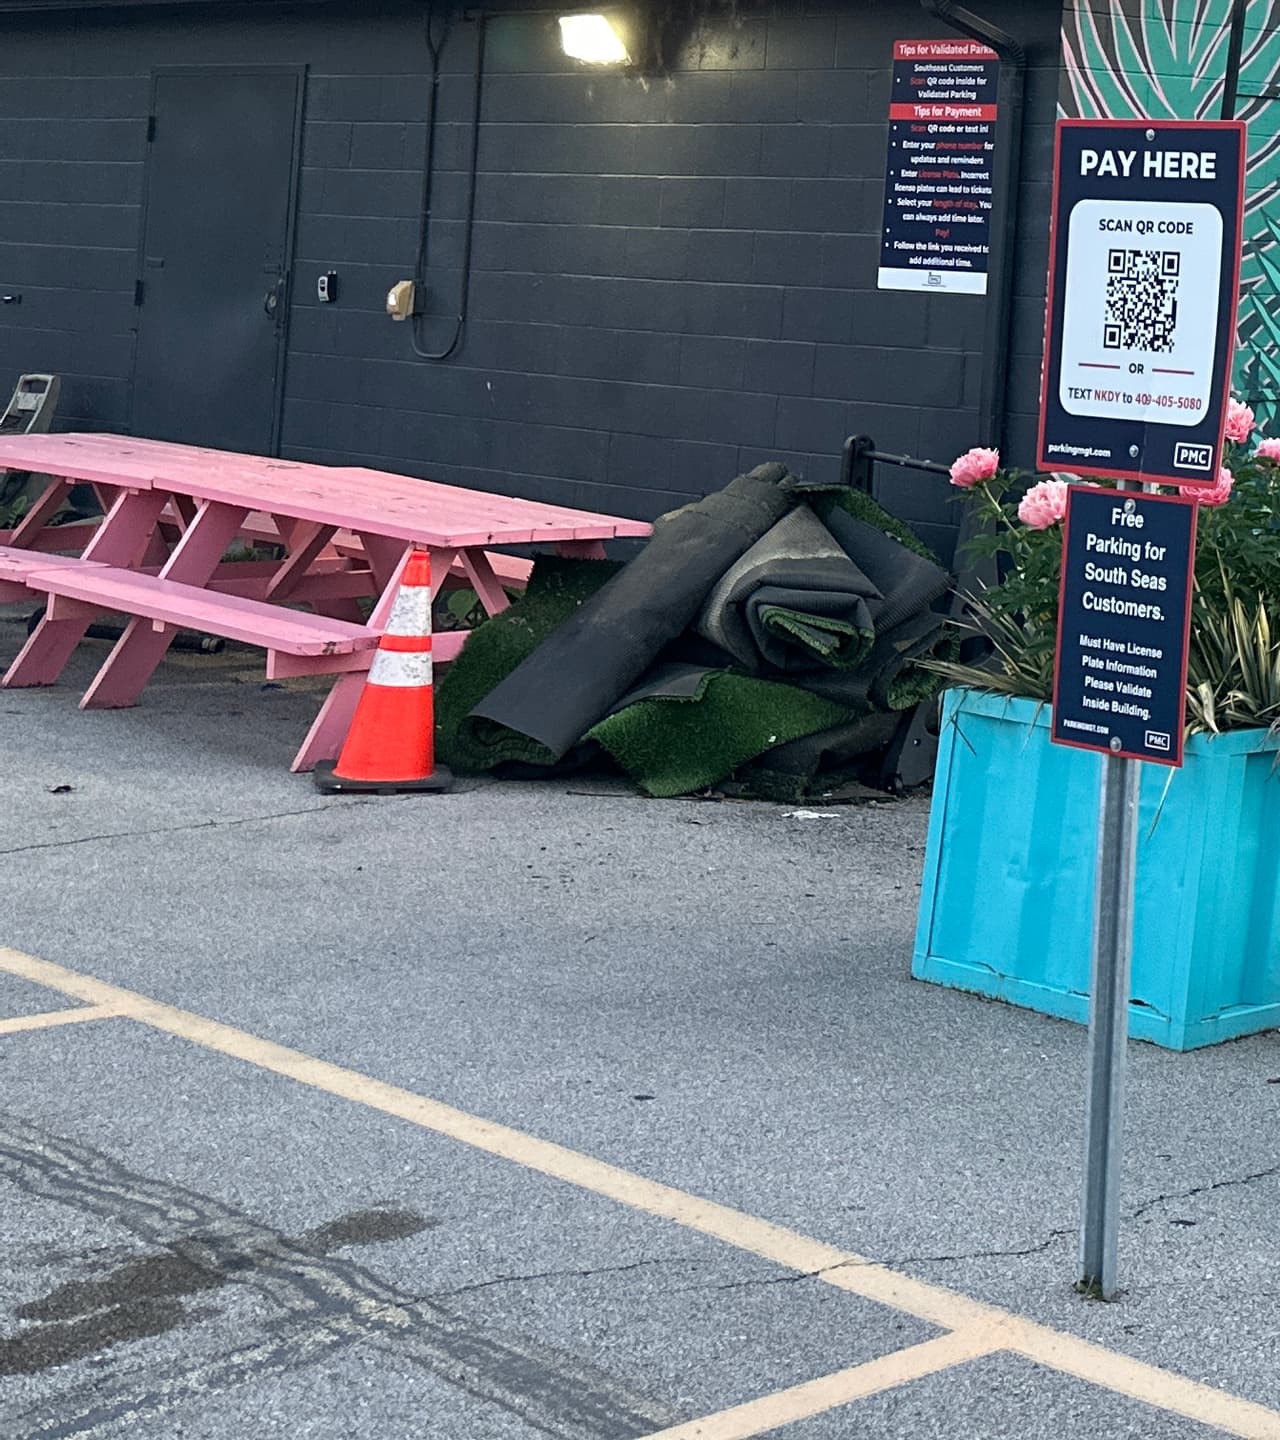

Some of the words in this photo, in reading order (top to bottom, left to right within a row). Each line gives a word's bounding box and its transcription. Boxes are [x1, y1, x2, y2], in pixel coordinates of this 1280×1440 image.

[900, 45, 916, 56] Tips
[917, 44, 928, 54] for
[930, 44, 968, 54] Validated
[948, 64, 984, 72] Customers
[911, 77, 926, 85] Scan
[927, 77, 937, 86] QR
[938, 77, 954, 85] code
[956, 77, 975, 85] inside
[977, 77, 987, 85] for
[918, 90, 949, 98] Validated
[950, 90, 976, 100] Parking
[914, 106, 930, 118] Tips
[932, 106, 944, 116] for
[945, 106, 982, 118] Payment
[927, 125, 938, 134] QR
[939, 125, 956, 133] code
[965, 125, 978, 133] text
[902, 140, 919, 149] Enter
[921, 142, 936, 150] your
[984, 142, 994, 150] for
[911, 155, 936, 164] updates
[937, 156, 950, 164] and
[951, 155, 984, 164] reminders
[1080, 150, 1136, 176] PAY
[1143, 150, 1216, 179] HERE
[901, 169, 918, 177] Enter
[961, 171, 989, 179] Incorrect
[894, 183, 916, 191] license
[916, 184, 935, 193] plates
[949, 185, 962, 193] lead
[971, 185, 992, 194] tickets
[897, 198, 916, 206] Select
[918, 200, 932, 208] your
[979, 200, 992, 209] You
[916, 213, 937, 223] always
[938, 214, 951, 222] add
[952, 214, 967, 223] time
[968, 214, 984, 223] later.
[1099, 219, 1132, 232] SCAN
[1136, 220, 1154, 235] QR
[1157, 221, 1193, 234] CODE
[894, 241, 914, 250] Follow
[916, 242, 927, 250] the
[928, 242, 940, 251] link
[941, 245, 953, 253] you
[954, 244, 982, 253] received
[909, 256, 921, 264] add
[922, 257, 954, 266] additional
[1129, 363, 1144, 374] OR
[1068, 387, 1092, 400] TEXT
[1094, 390, 1121, 402] NKDY
[1122, 393, 1132, 403] to
[1048, 443, 1111, 458] parkingmgt.com
[1180, 449, 1207, 464] PMC
[1112, 507, 1144, 528] Free
[1086, 533, 1141, 562] Parking
[1145, 541, 1166, 560] for
[1085, 562, 1127, 585] South
[1131, 569, 1167, 591] Seas
[1082, 591, 1165, 621] Customers.
[1080, 634, 1101, 648] Must
[1103, 638, 1125, 653] Have
[1127, 642, 1162, 659] License
[1082, 655, 1104, 669] Plate
[1106, 659, 1158, 678] Information
[1085, 675, 1114, 691] Please
[1116, 681, 1152, 698] Validate
[1082, 696, 1110, 711] Inside
[1111, 701, 1152, 720] Building.
[1149, 735, 1167, 746] PMC
